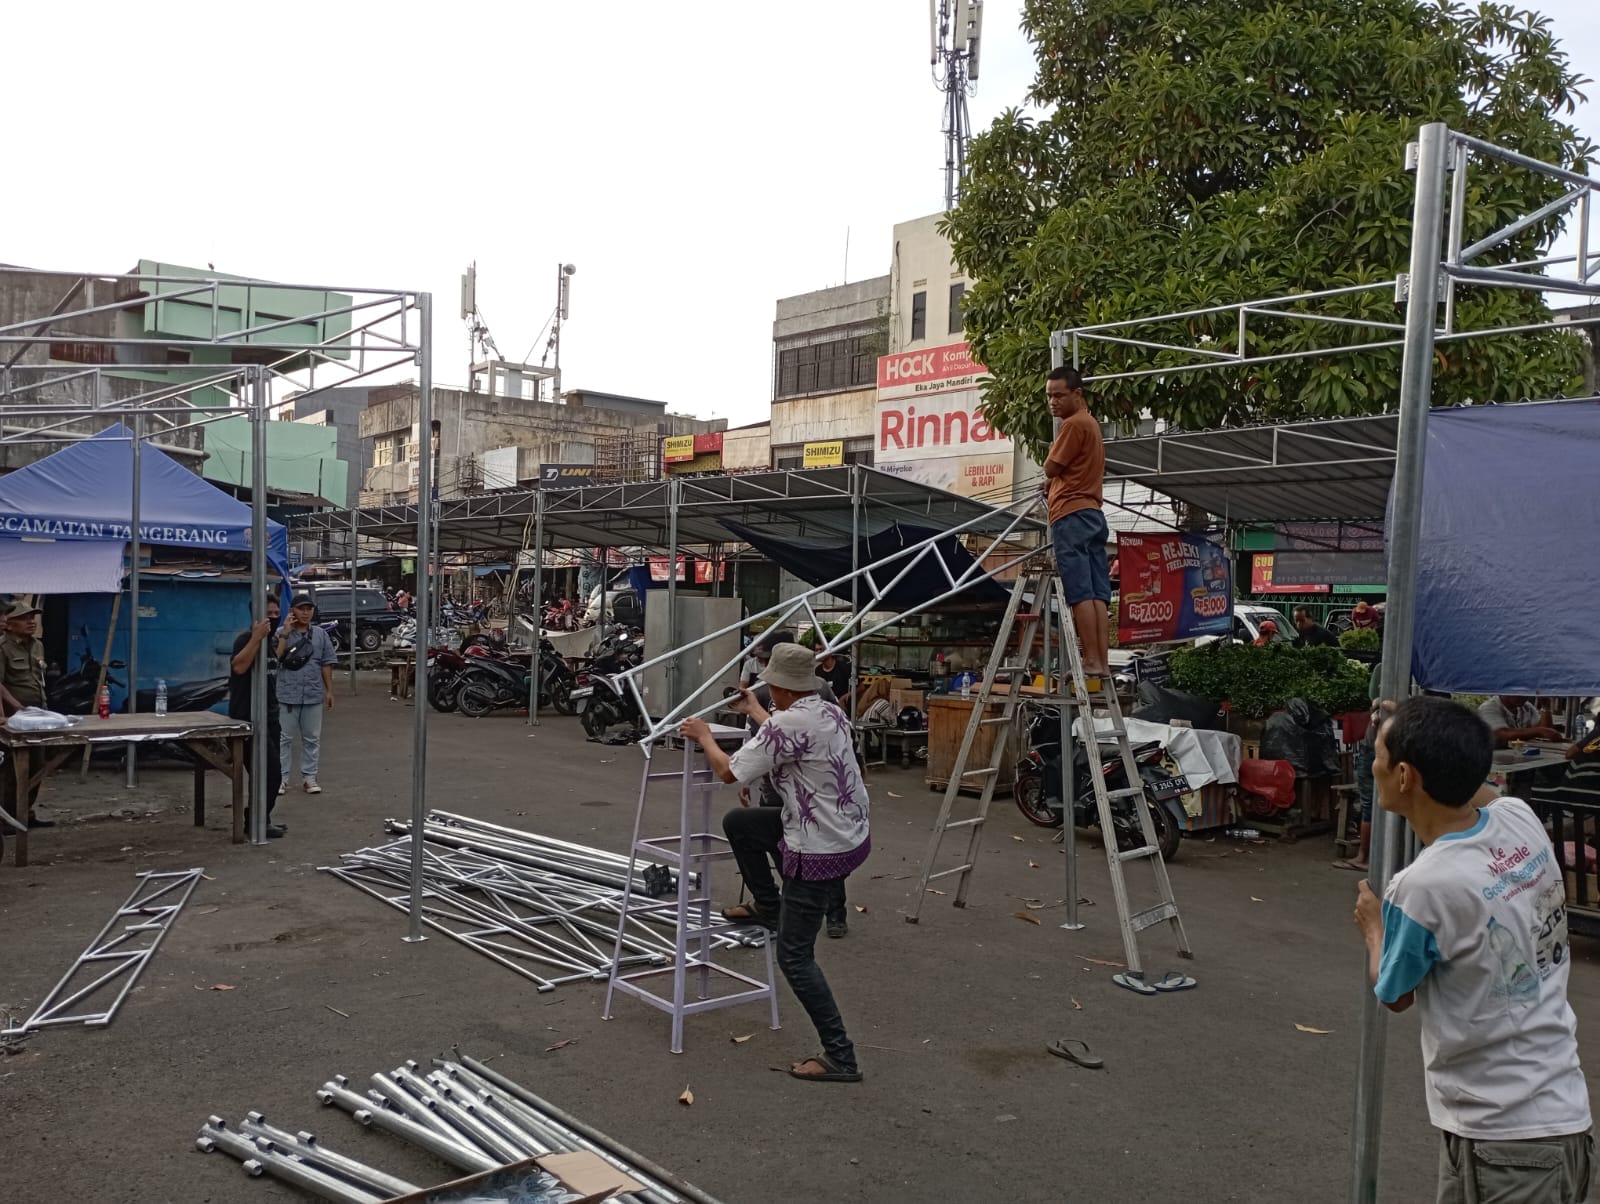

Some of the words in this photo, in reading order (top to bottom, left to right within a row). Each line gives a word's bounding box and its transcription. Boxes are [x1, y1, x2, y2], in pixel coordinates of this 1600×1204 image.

[886, 353, 935, 381] HOCK
[943, 351, 972, 363] Komp
[915, 383, 928, 392] Eka
[929, 382, 945, 391] Jaya
[946, 376, 973, 387] Mandiri
[880, 406, 1007, 451] Rinna
[666, 439, 692, 449] SHIMIZU
[806, 446, 841, 456] SHIMIZU
[886, 465, 913, 474] Miyako
[964, 465, 985, 477] LEBIH
[985, 463, 1004, 476] LICIN
[971, 478, 978, 487] &
[978, 476, 995, 487] RAPI
[109, 523, 228, 544] TANGERANG
[1161, 542, 1200, 561] REJEKI
[1166, 558, 1201, 573] FREELANCER
[1129, 601, 1173, 624] Rp7.000
[1194, 595, 1227, 617] Rp5.000
[1487, 846, 1530, 876] Minerale
[1489, 847, 1506, 861] Le
